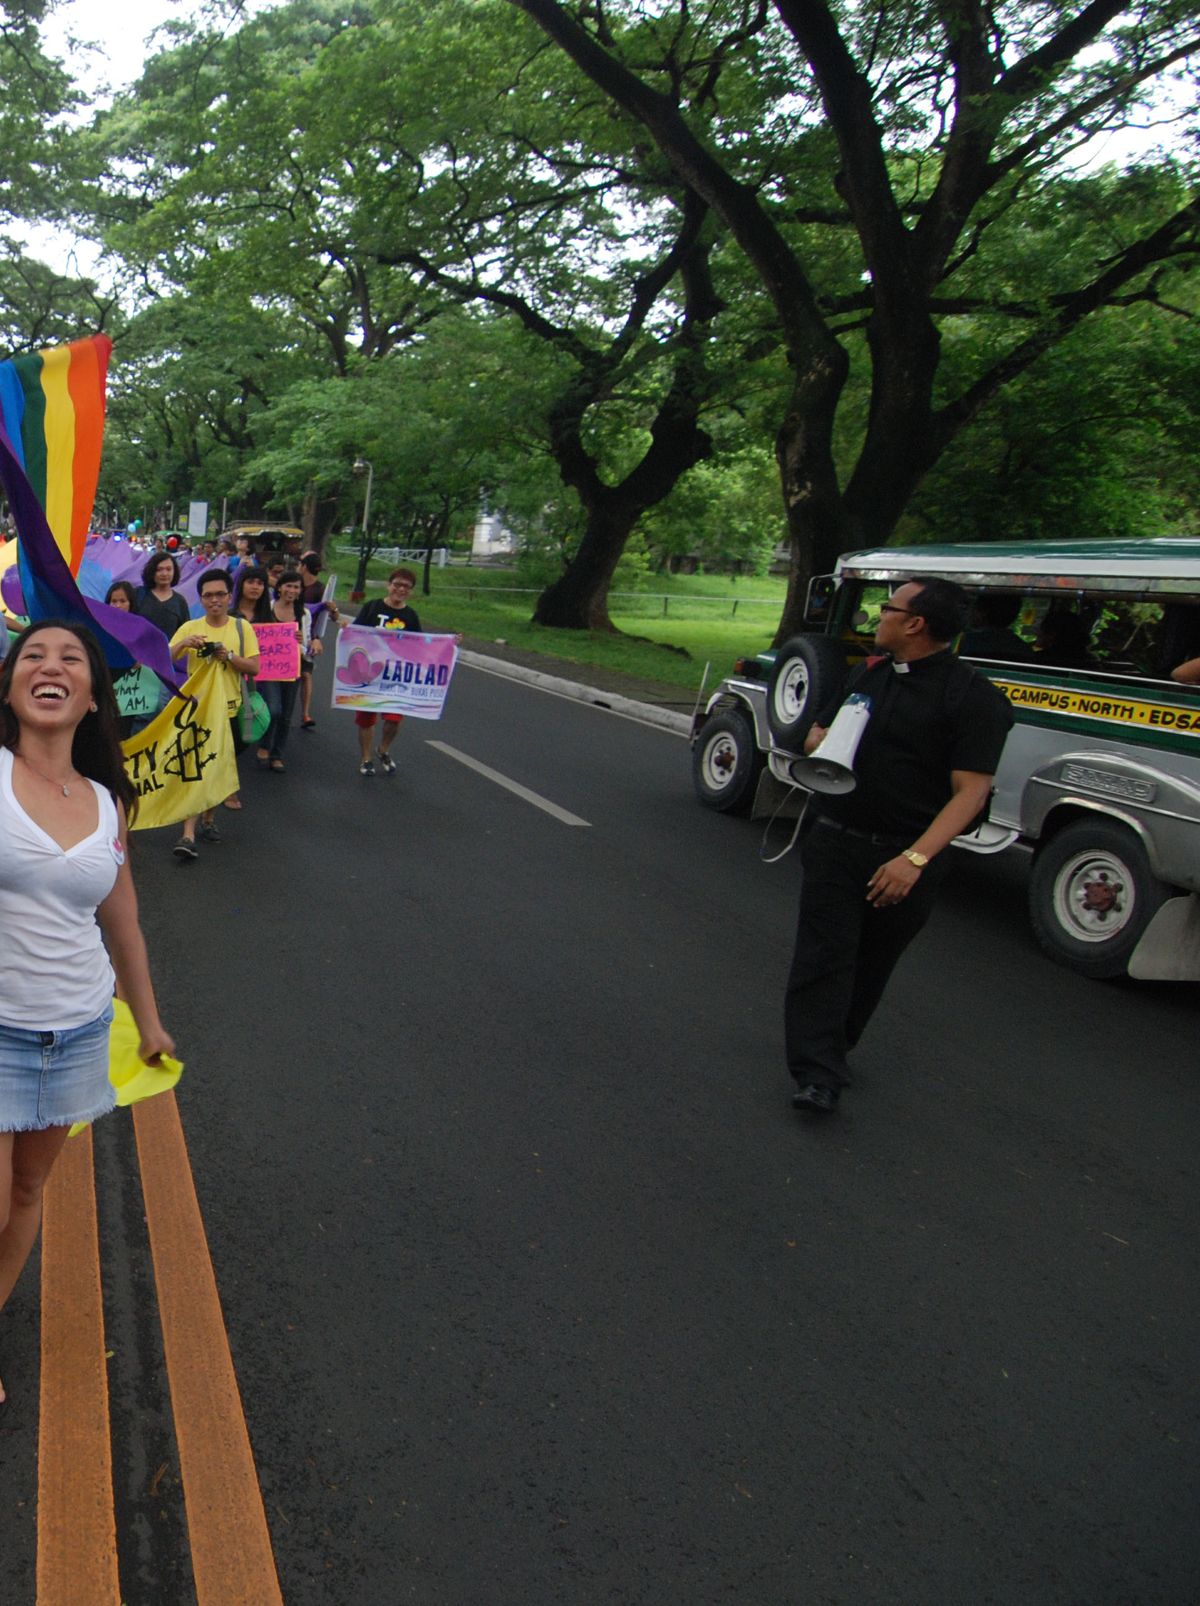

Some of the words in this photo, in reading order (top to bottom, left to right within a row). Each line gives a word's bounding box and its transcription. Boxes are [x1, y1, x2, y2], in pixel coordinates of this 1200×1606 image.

[382, 659, 449, 686] LADLAD
[1010, 688, 1070, 709] CAMPUS
[1078, 698, 1134, 719] NORTH
